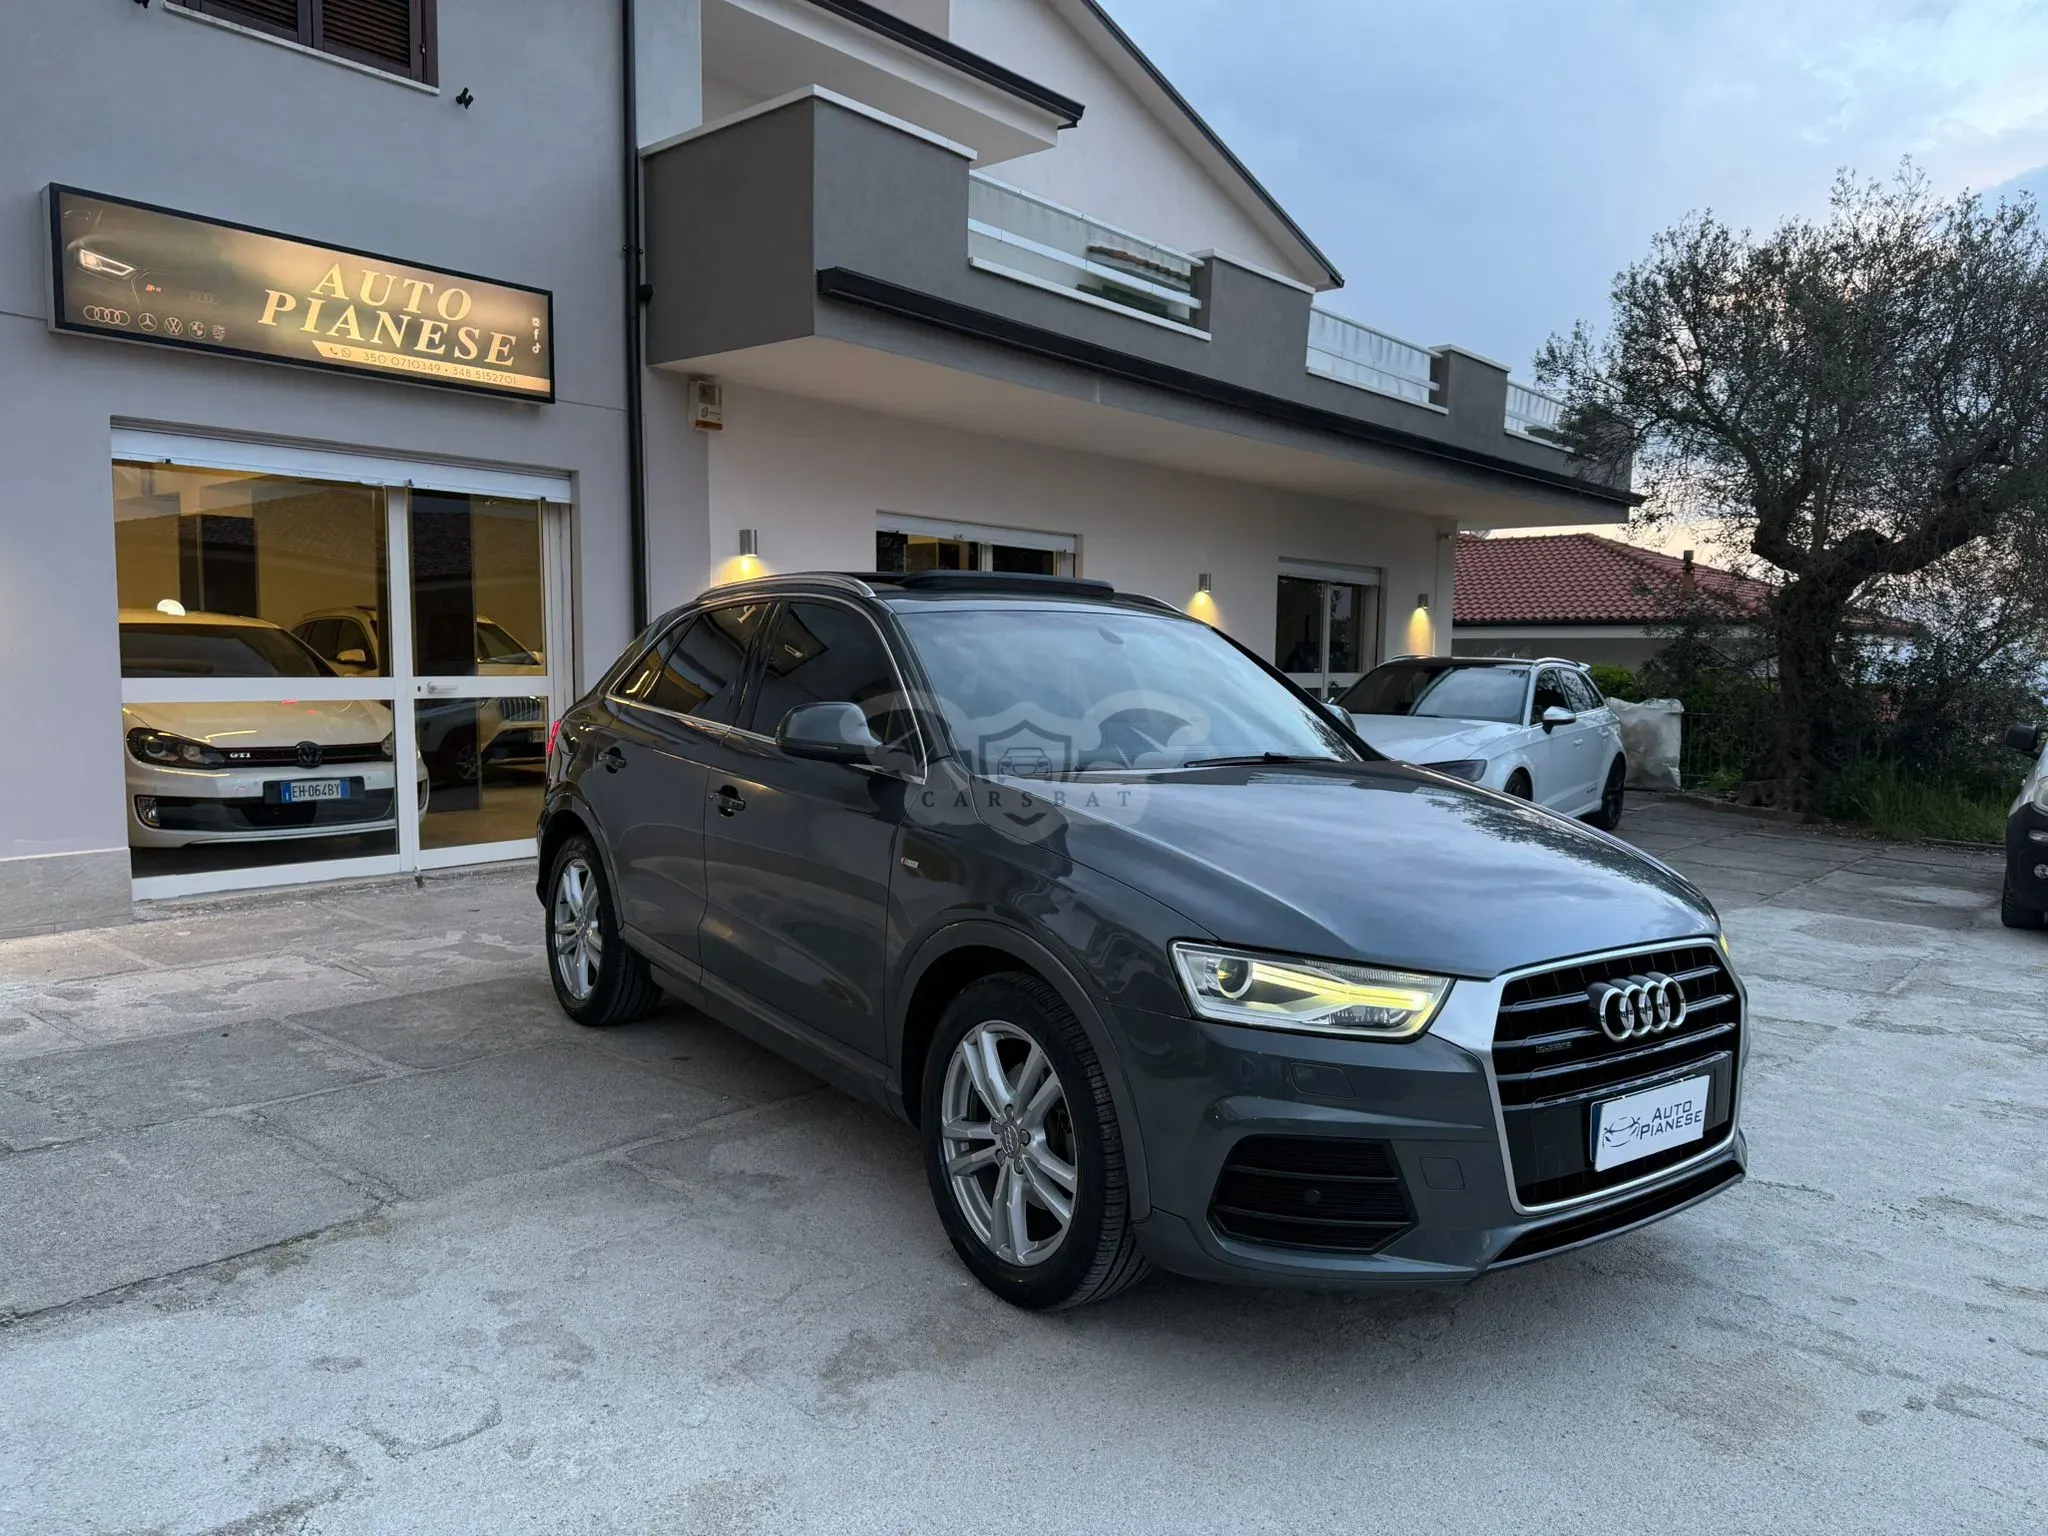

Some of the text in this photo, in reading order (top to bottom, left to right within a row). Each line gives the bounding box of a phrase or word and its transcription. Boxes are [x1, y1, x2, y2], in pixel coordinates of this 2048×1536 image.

[310, 263, 472, 321] AUTO
[257, 289, 517, 366] PIANESE
[363, 351, 517, 385] 350 0710349 348 5152701
[229, 751, 251, 759] GTI
[1639, 1109, 1703, 1140] PIANESE
[1651, 1100, 1693, 1123] AUTO
